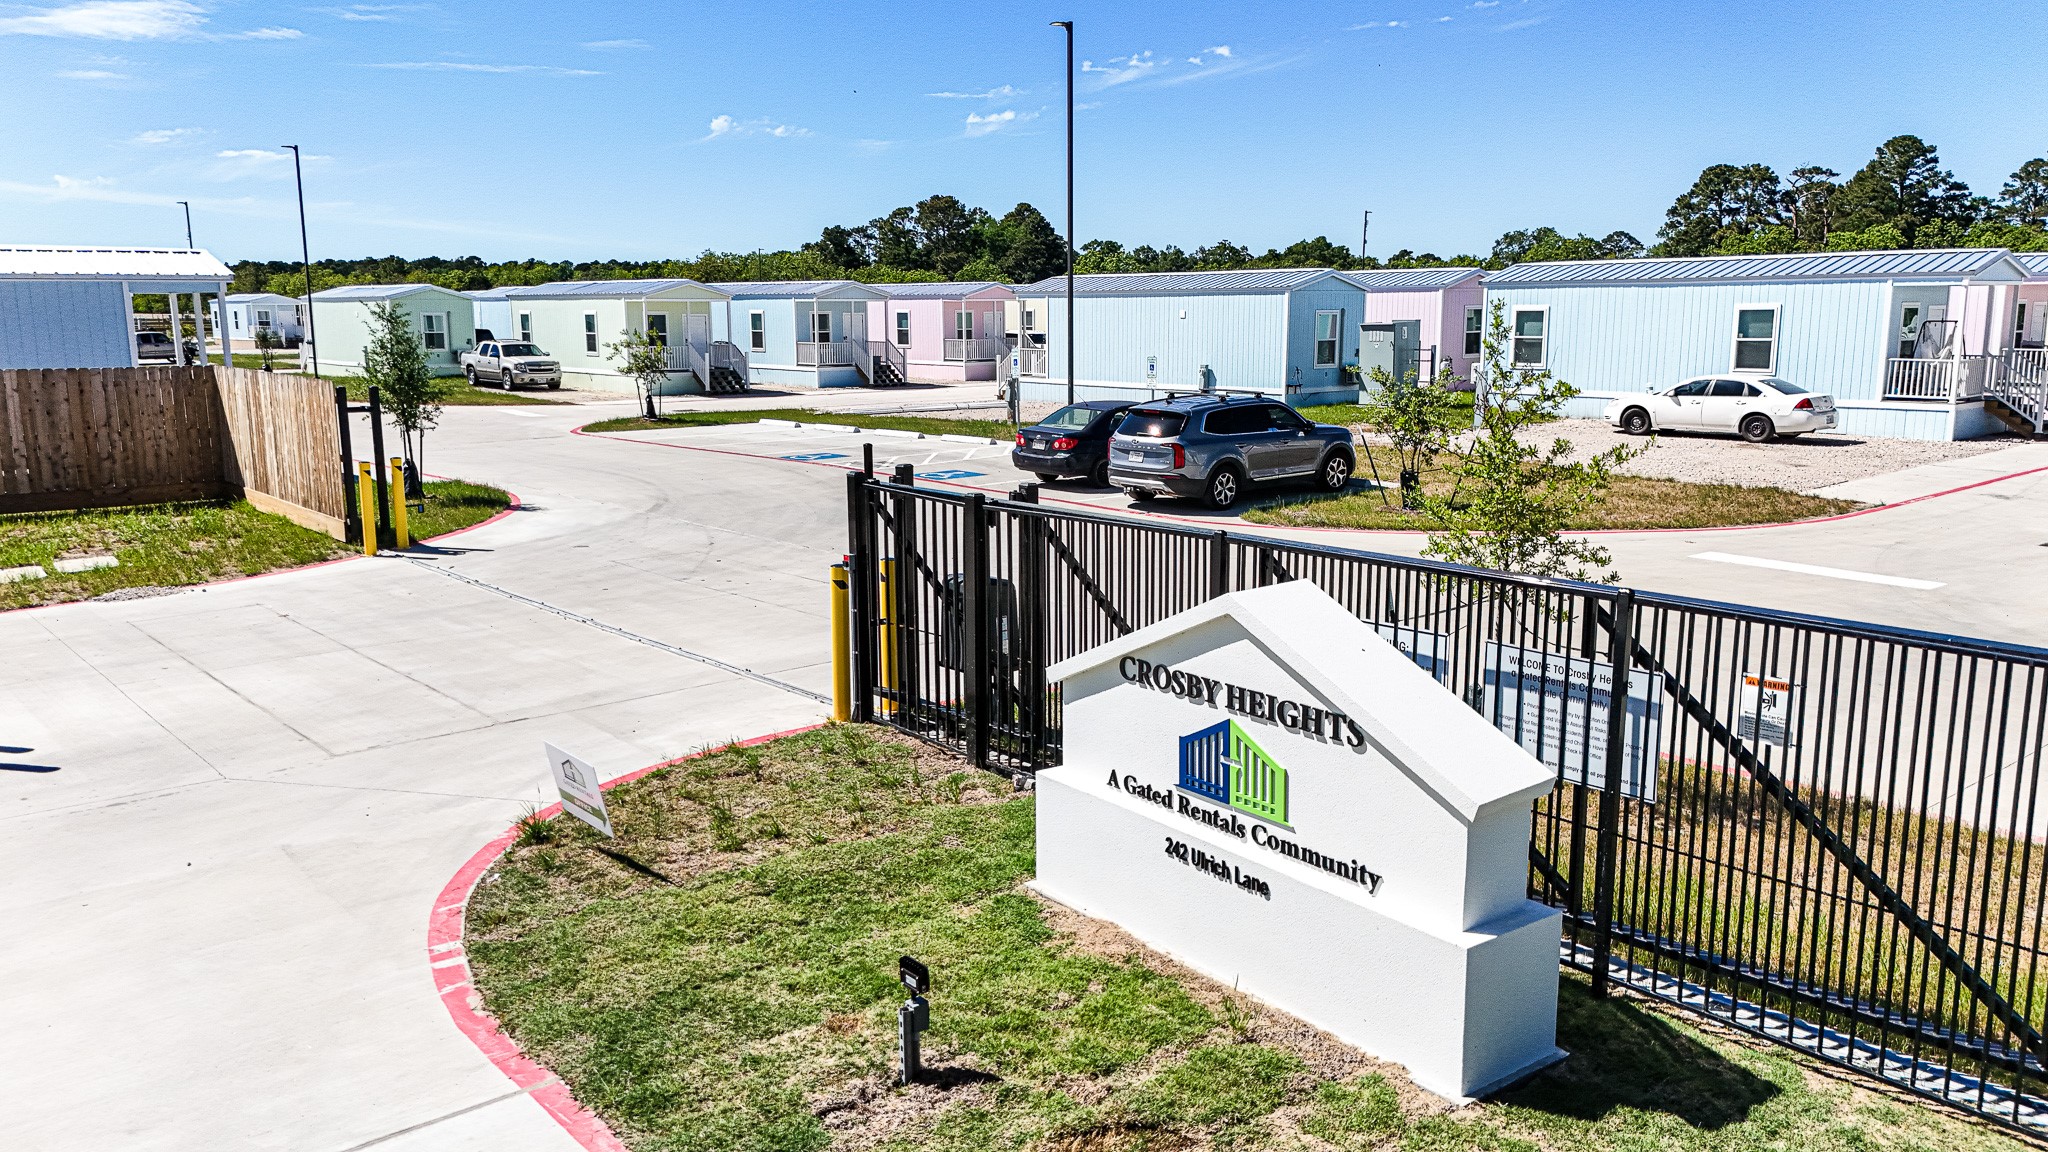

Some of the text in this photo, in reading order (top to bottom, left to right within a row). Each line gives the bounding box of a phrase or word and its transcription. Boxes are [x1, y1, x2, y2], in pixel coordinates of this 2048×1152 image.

[1509, 655, 1551, 673] WLCOE
[1553, 664, 1565, 675] TO
[1545, 676, 1577, 690] Rentls
[1757, 679, 1790, 691] ARNING
[1119, 655, 1366, 748] CROSBY HEIGHTS
[1529, 684, 1608, 711] Priate Cmmnity
[1106, 769, 1384, 897] A Gated Rentals Community
[1165, 836, 1270, 896] 242 Ulrich Lane
